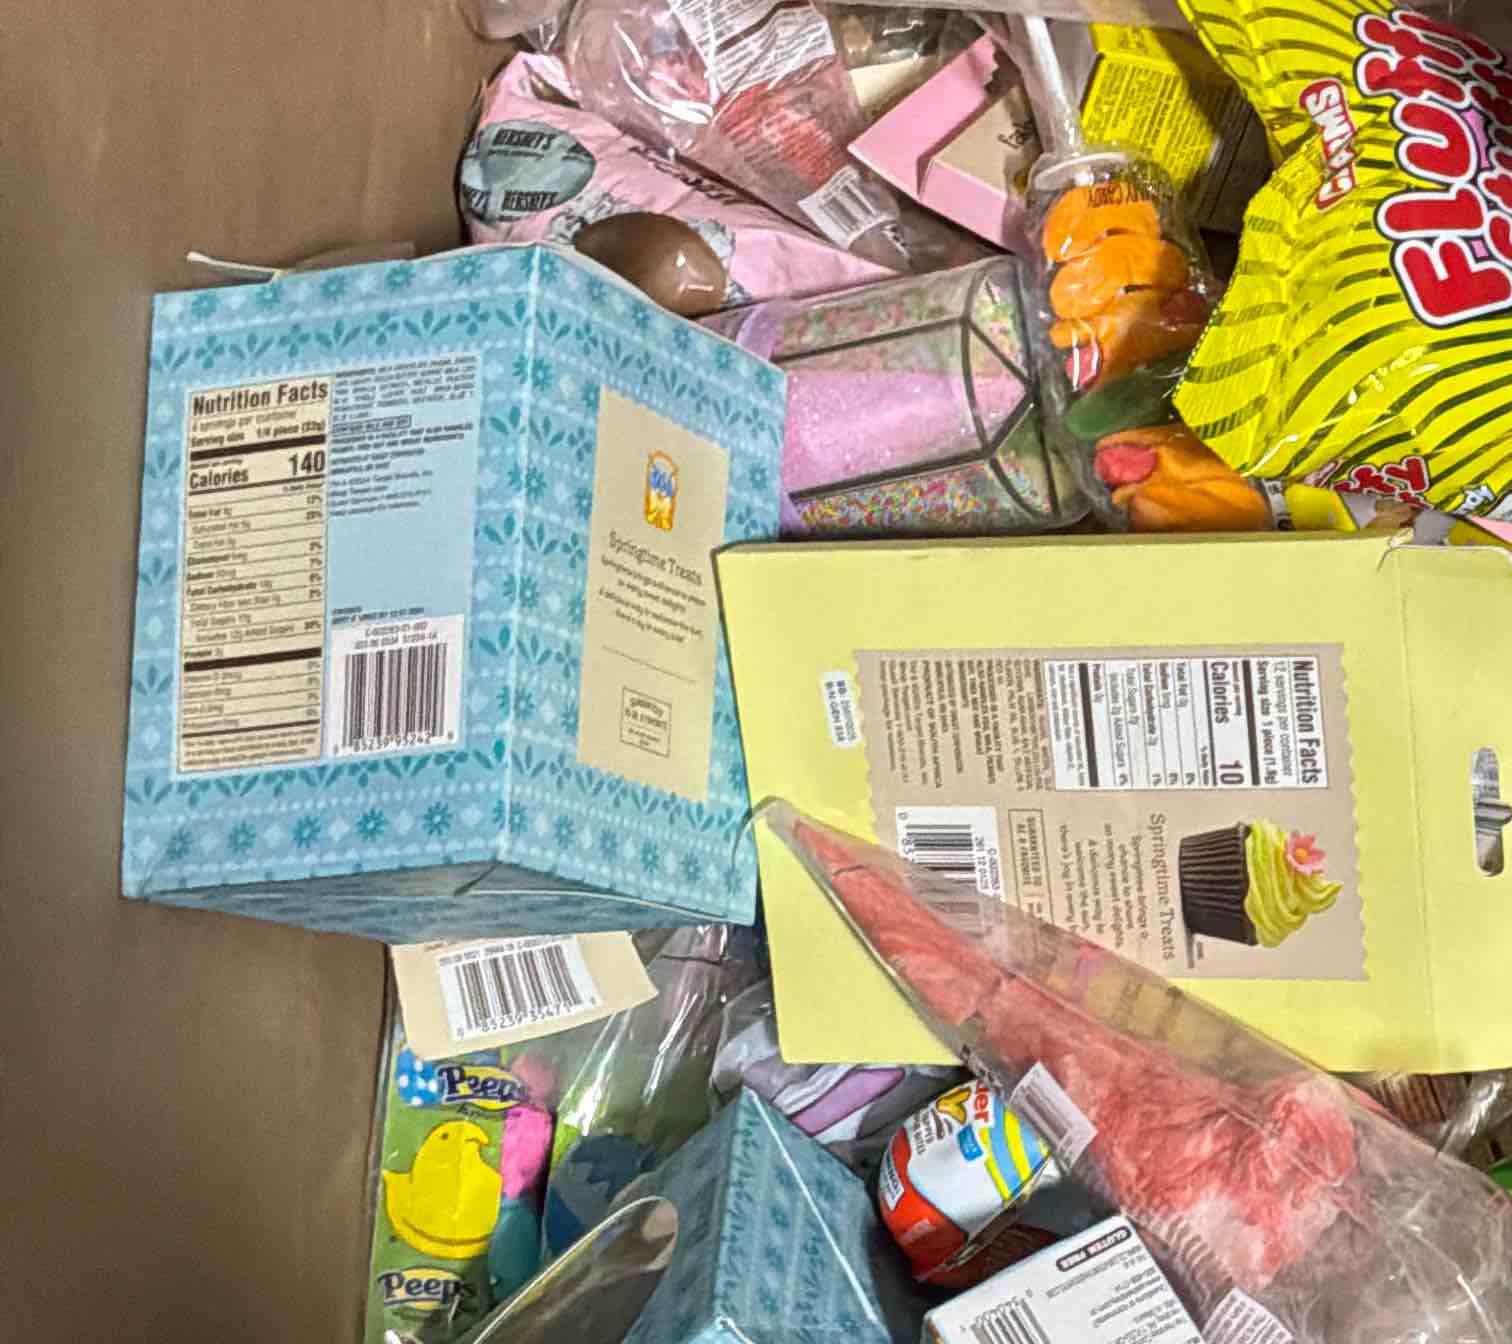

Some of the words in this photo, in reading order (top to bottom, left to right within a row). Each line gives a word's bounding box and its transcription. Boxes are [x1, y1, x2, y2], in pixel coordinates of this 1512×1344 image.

[193, 389, 270, 416] Nutrition
[277, 380, 328, 404] Facts
[189, 468, 248, 489] Calories
[289, 450, 325, 475] 140
[667, 556, 702, 587] Treats
[1210, 661, 1232, 724] Calories
[1256, 660, 1269, 695] Serving
[1260, 697, 1271, 715] size
[1292, 660, 1317, 732] Nutrition
[1261, 729, 1274, 754] piece
[1218, 760, 1244, 785] 10
[1298, 737, 1321, 784] Facts
[1147, 813, 1170, 905] Springtime
[1159, 908, 1175, 960] Treats
[1087, 1227, 1127, 1254] GLUTEN
[1057, 1249, 1087, 1271] FREE
